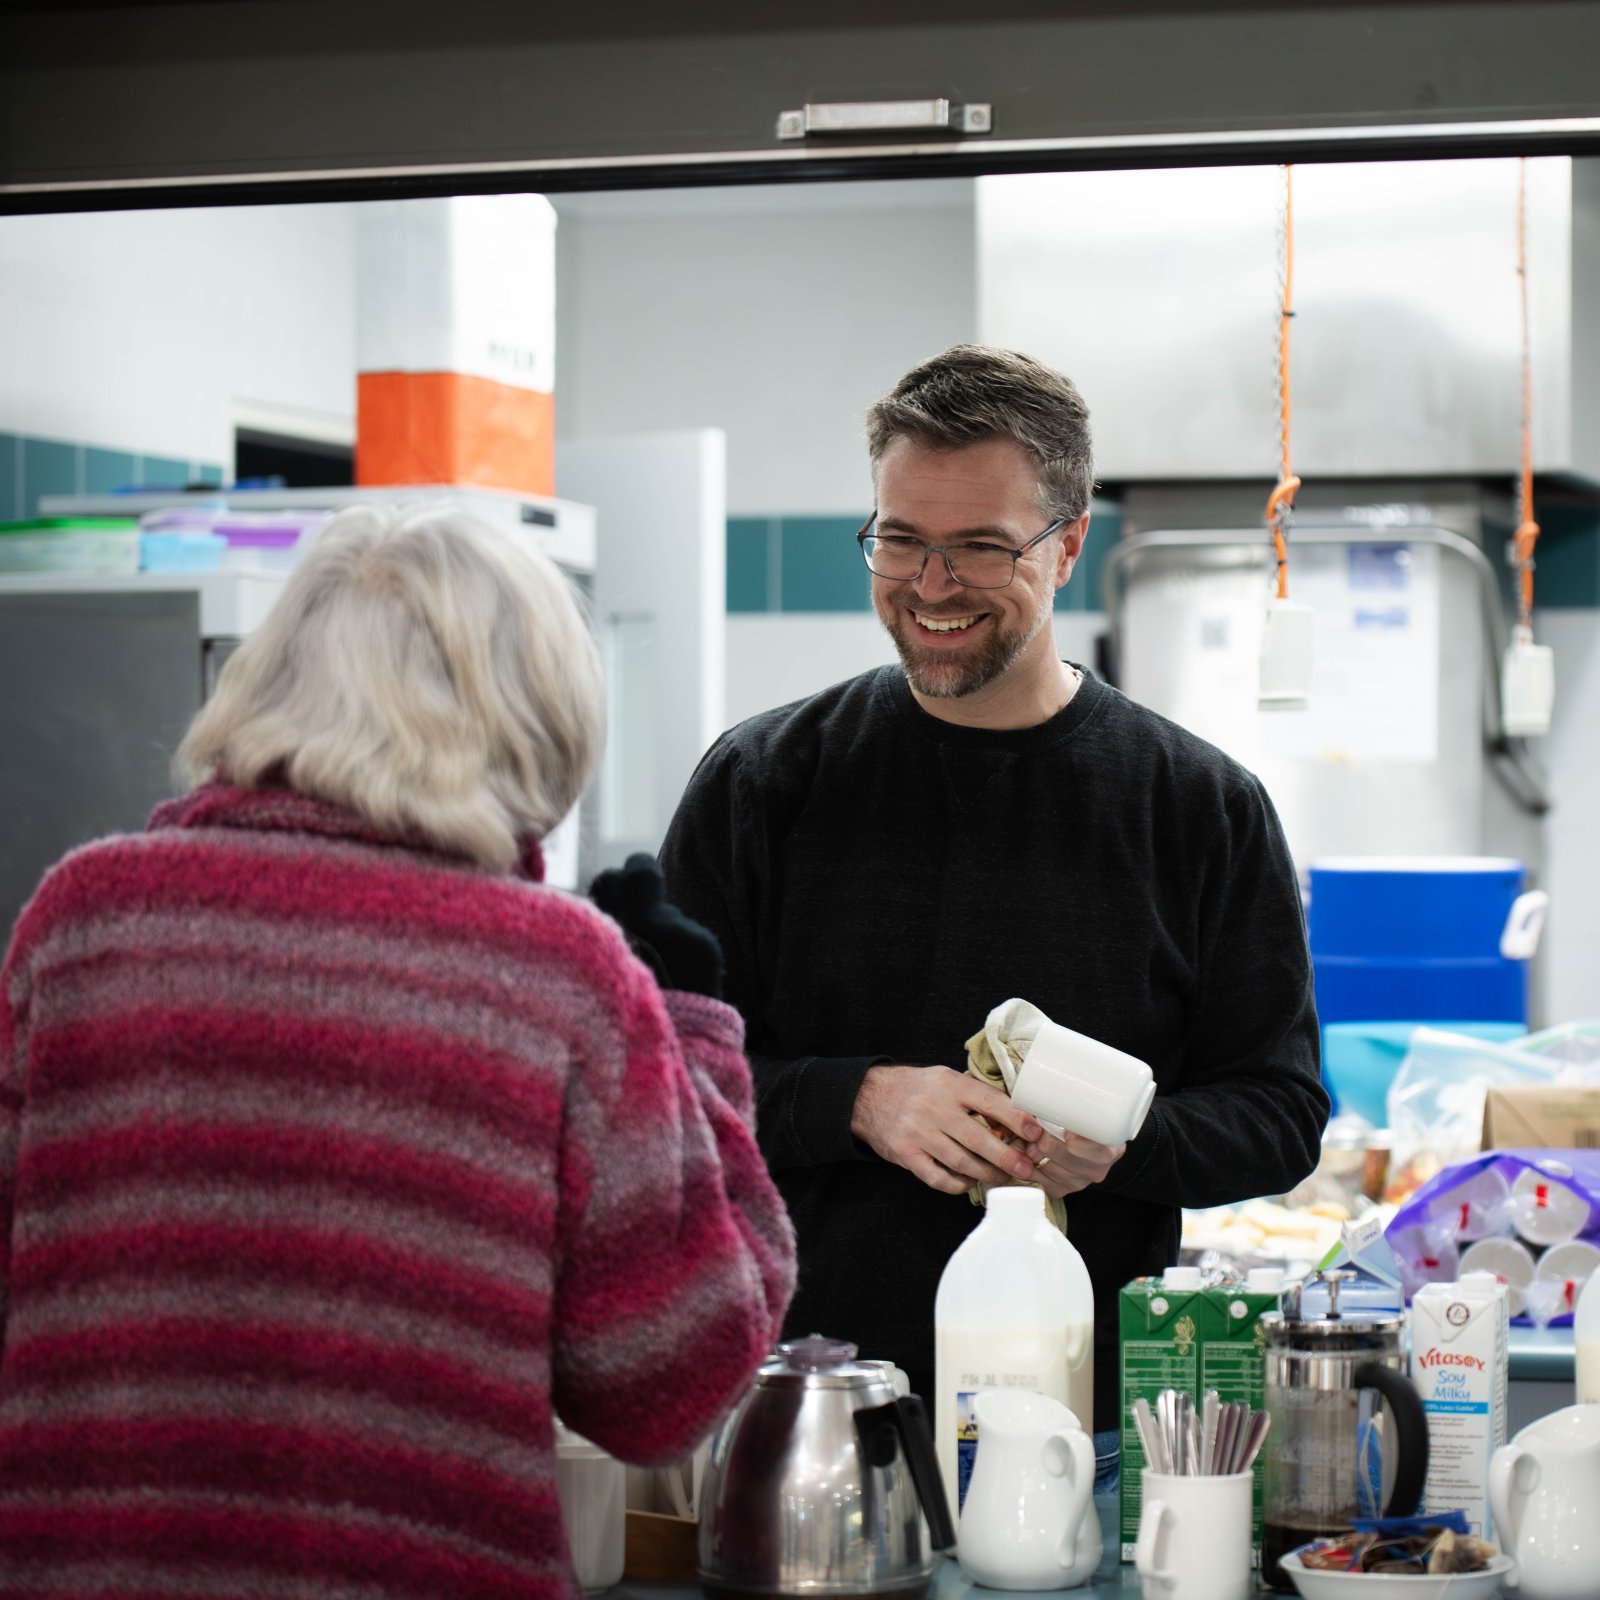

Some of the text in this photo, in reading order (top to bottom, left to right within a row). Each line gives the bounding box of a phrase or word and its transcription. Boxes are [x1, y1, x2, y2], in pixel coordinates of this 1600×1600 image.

[1419, 1348, 1486, 1371] Vitasoy
[1438, 1370, 1466, 1388] Soy
[1433, 1387, 1471, 1402] Milky
